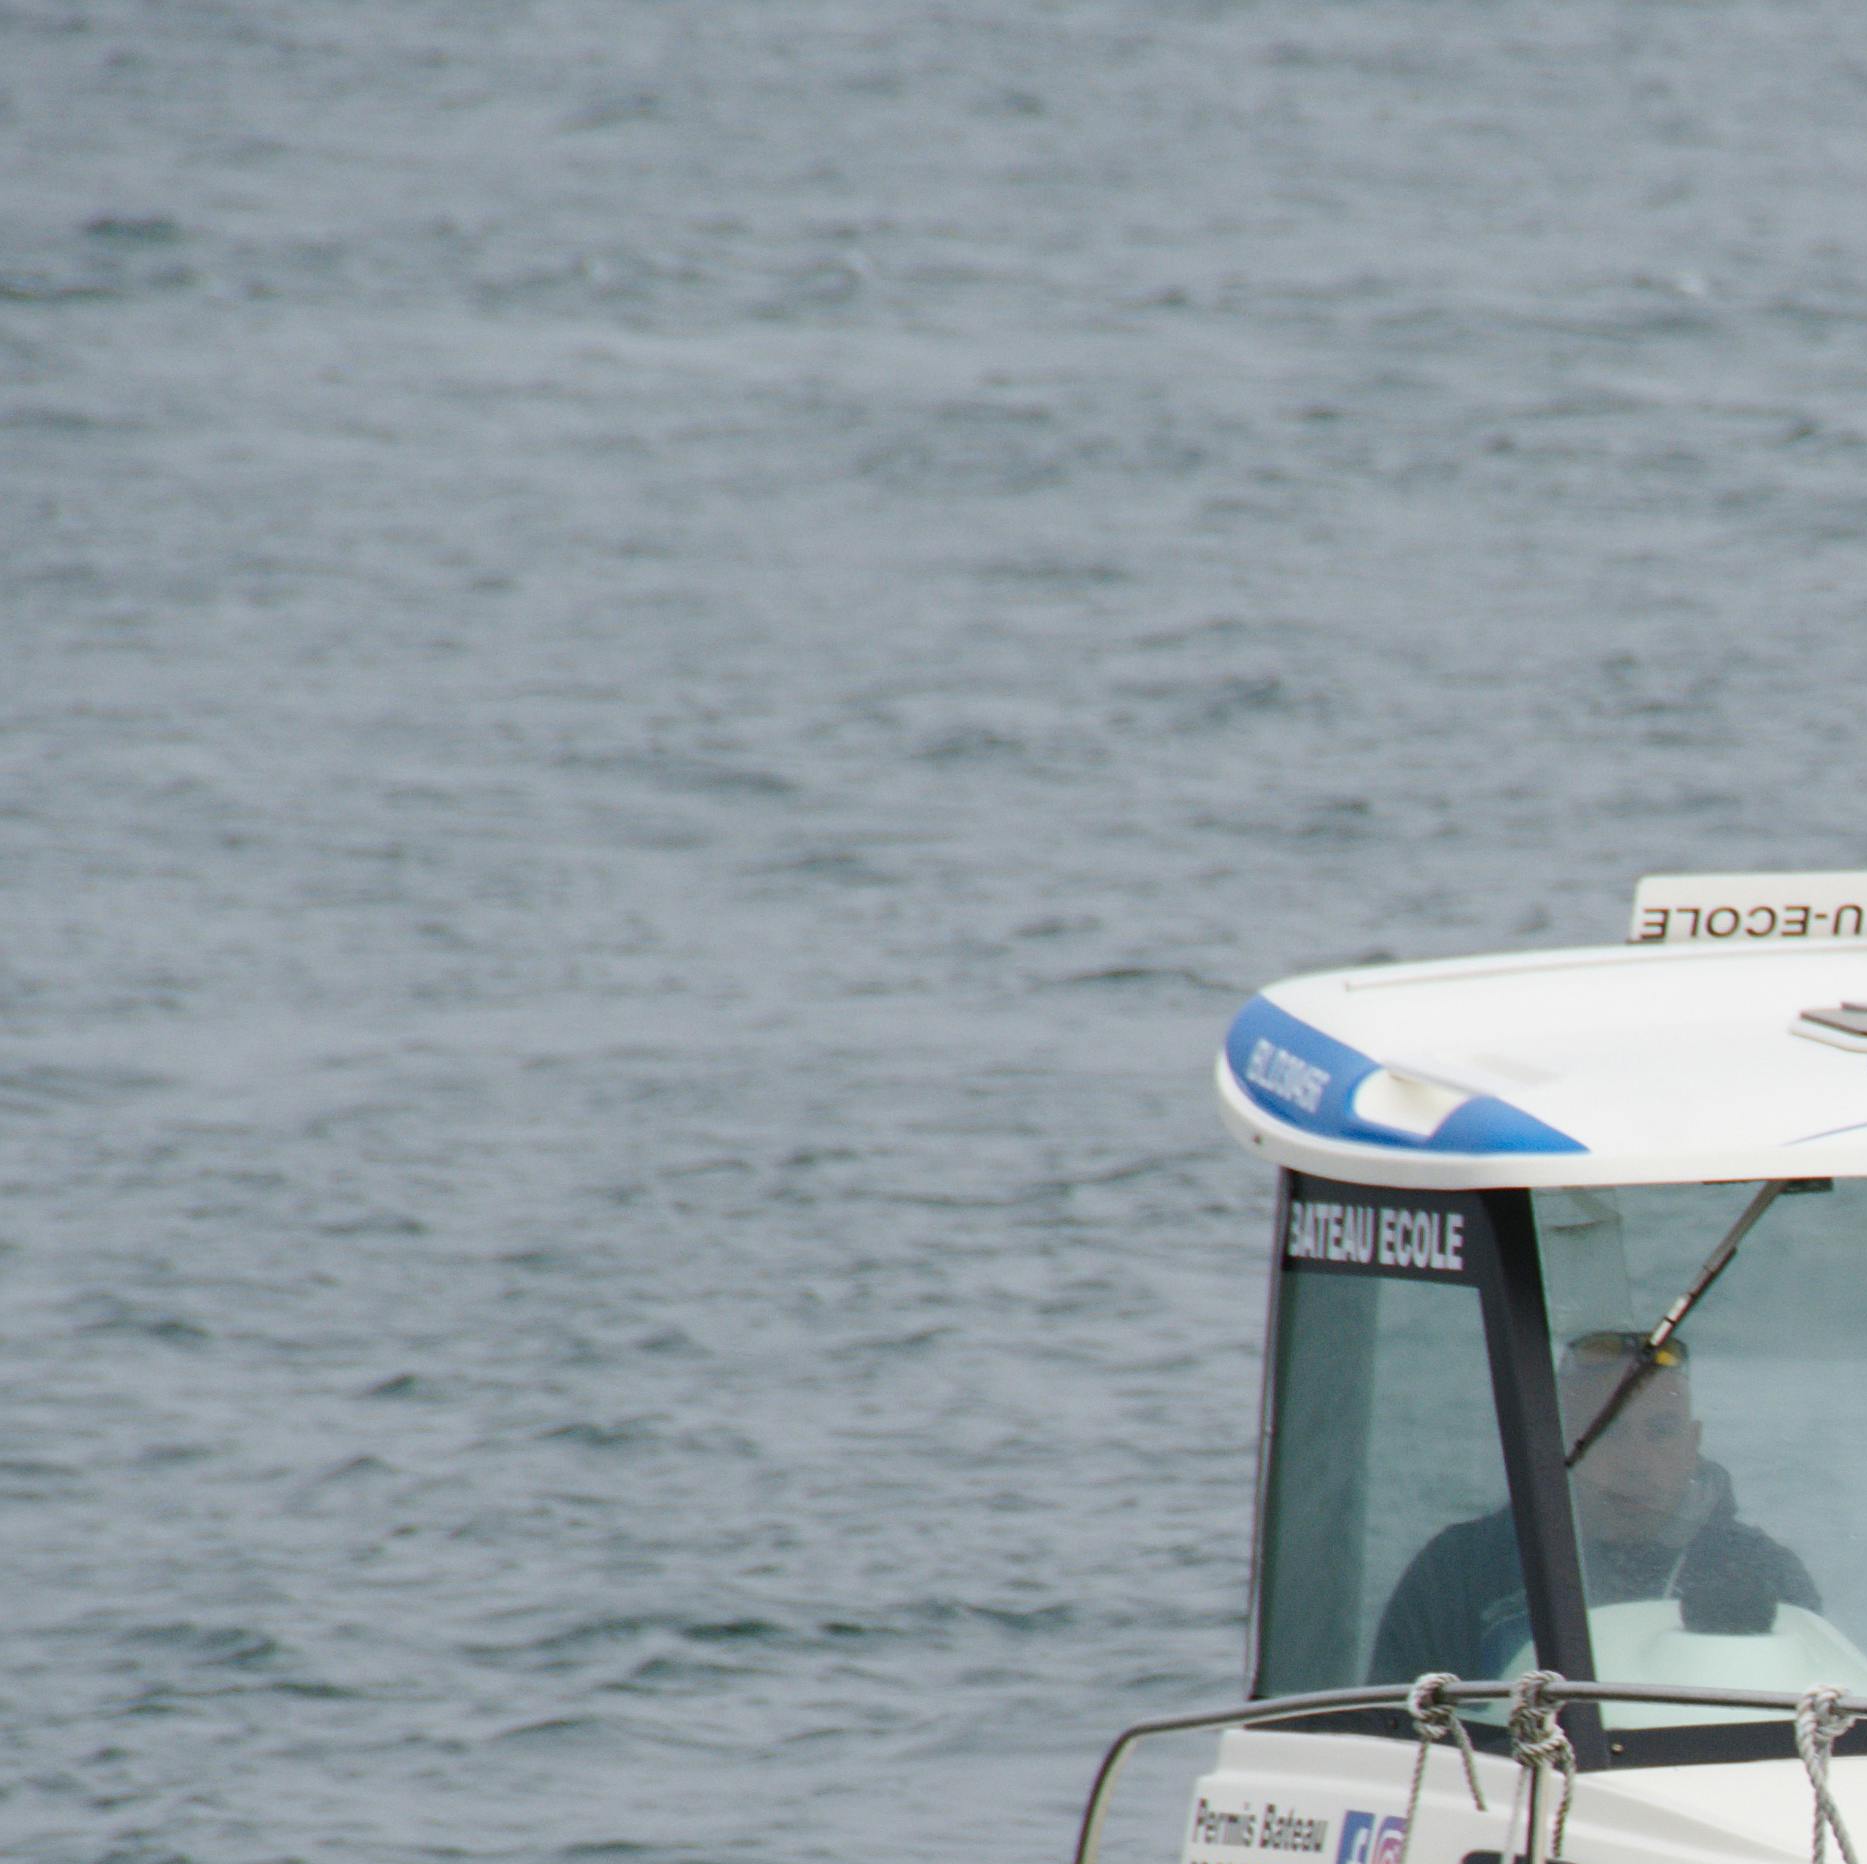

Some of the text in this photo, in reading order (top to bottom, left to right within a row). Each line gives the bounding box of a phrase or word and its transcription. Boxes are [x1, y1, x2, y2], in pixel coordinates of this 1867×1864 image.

[1287, 1201, 1465, 1272] BATEAU ECOLE
[1191, 1797, 1329, 1853] Permis Bateau
